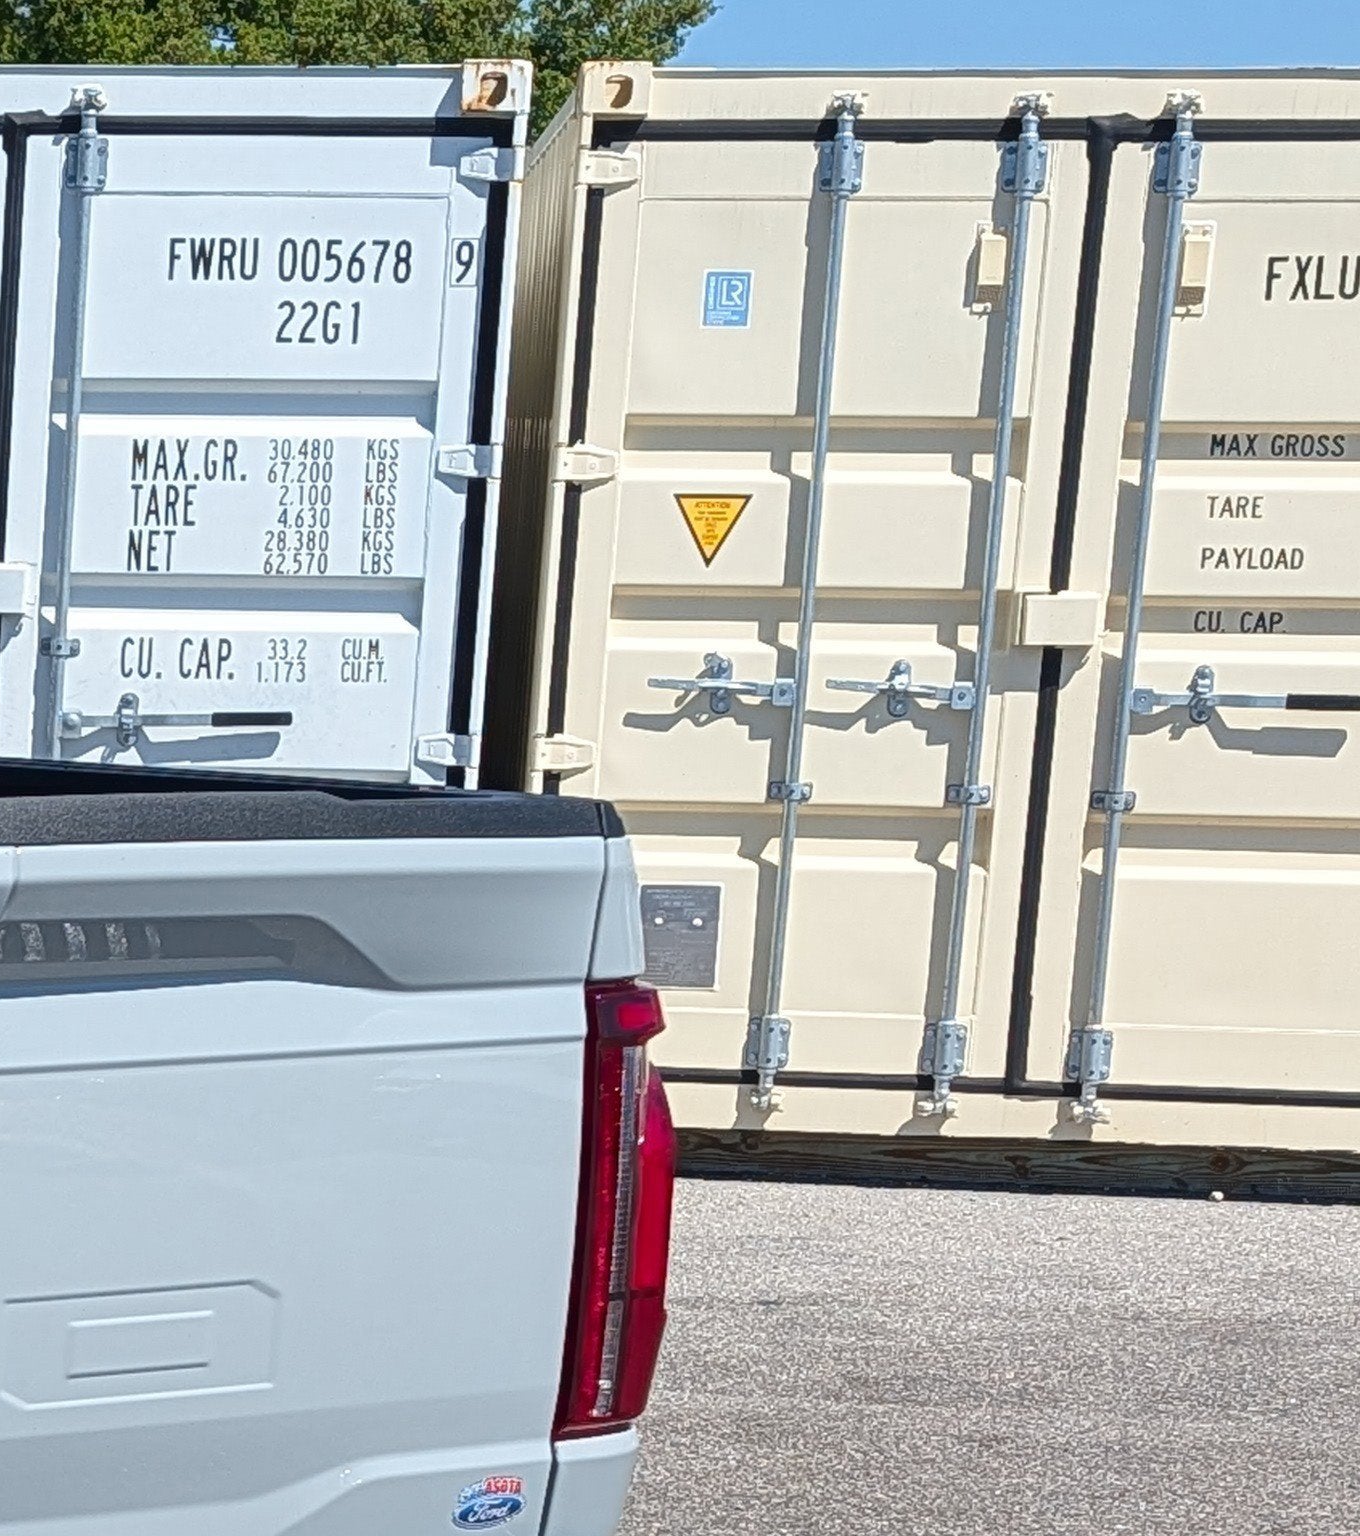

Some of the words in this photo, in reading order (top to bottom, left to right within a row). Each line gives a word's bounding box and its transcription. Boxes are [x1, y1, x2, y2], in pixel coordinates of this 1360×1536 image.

[167, 237, 260, 281] FWRU
[278, 239, 413, 284] 005678
[455, 240, 475, 283] 9
[1264, 255, 1360, 301] FXLU
[275, 300, 362, 344] 22G1
[1209, 434, 1258, 458] MAX
[1270, 434, 1346, 458] GROSS
[131, 438, 247, 482] MAX.GR.
[268, 438, 334, 461] 30.480
[366, 438, 400, 460] KGS
[267, 462, 334, 484] 67.200
[365, 462, 398, 483] LBS
[131, 484, 198, 527] TARE
[278, 484, 332, 507] 2.100
[363, 484, 397, 506] KGS
[1206, 496, 1264, 519] TARE
[277, 507, 331, 530] 4.630
[362, 507, 396, 530] LBS
[126, 530, 177, 572] NET
[263, 530, 330, 552] 28.380
[361, 530, 394, 552] KGS
[1200, 547, 1305, 571] PAYLOAD
[262, 553, 329, 575] 62.570
[360, 553, 394, 575] LBS
[1193, 611, 1226, 633] CU.
[1240, 611, 1287, 634] CAP.
[120, 637, 162, 680] CU.
[179, 638, 235, 680] CAP.
[267, 638, 308, 660] 33.2
[256, 661, 307, 684] 1.173
